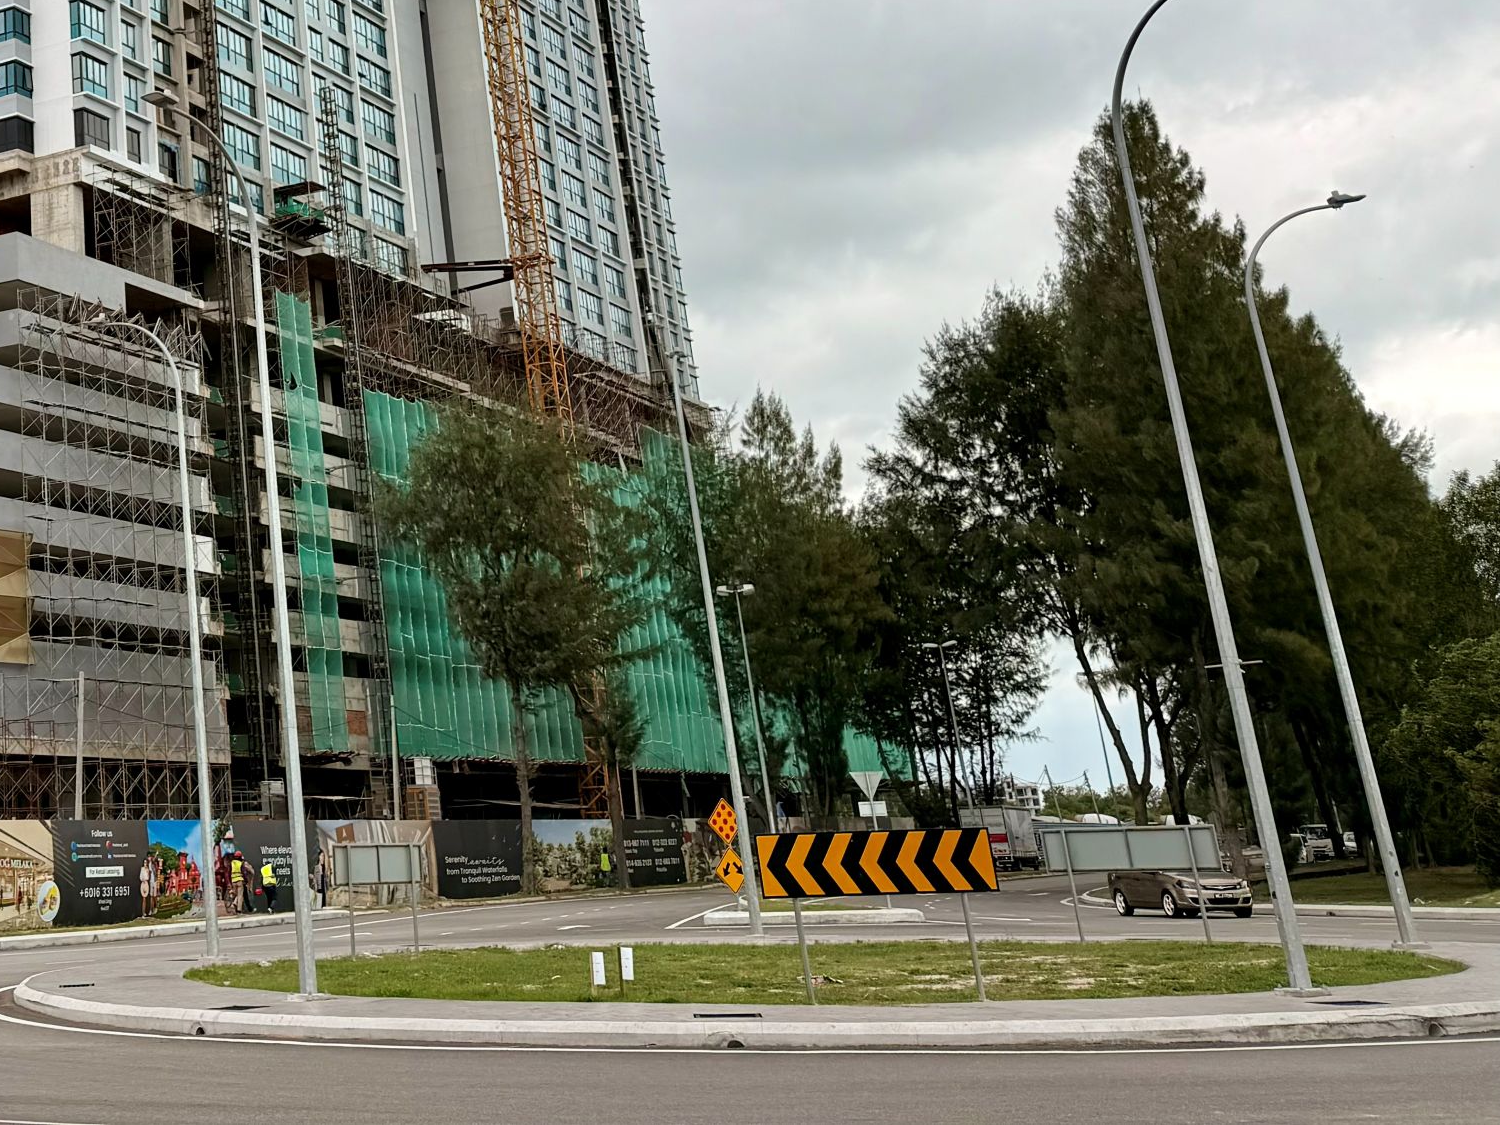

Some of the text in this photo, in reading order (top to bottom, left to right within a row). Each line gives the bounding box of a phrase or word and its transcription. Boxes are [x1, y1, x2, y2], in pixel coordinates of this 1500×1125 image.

[91, 829, 106, 838] Follow
[260, 845, 292, 855] Where eleva
[0, 858, 11, 868] OG
[444, 856, 468, 865] Serenity
[460, 867, 482, 875] Tranquil
[468, 876, 492, 884] Soothing
[79, 885, 130, 898] +6016 331 6951
